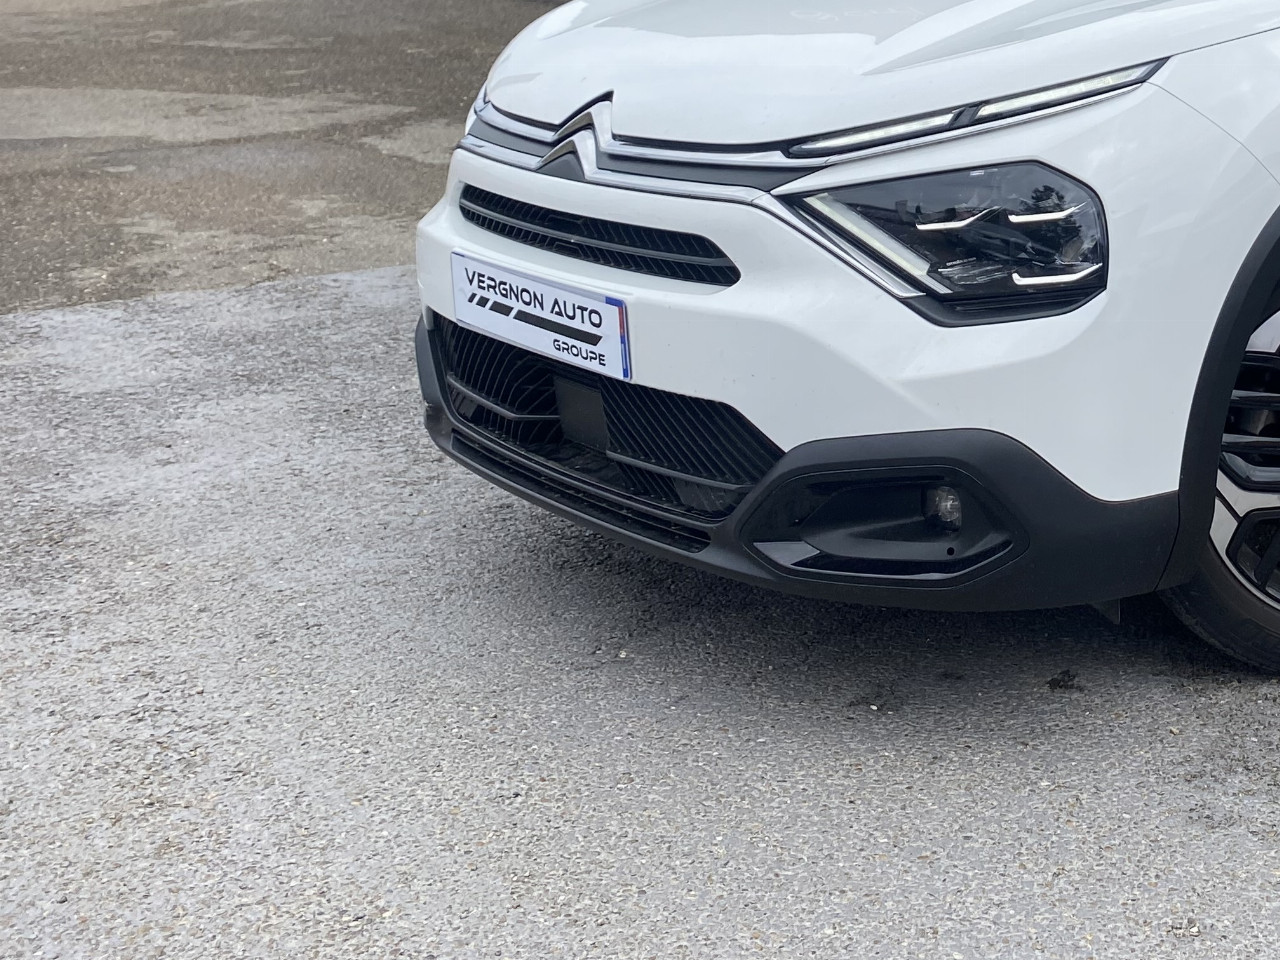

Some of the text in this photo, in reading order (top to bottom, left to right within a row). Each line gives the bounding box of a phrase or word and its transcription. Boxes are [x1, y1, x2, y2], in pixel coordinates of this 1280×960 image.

[464, 267, 603, 329] VERGNON AUTO
[552, 338, 606, 367] GROUPE
